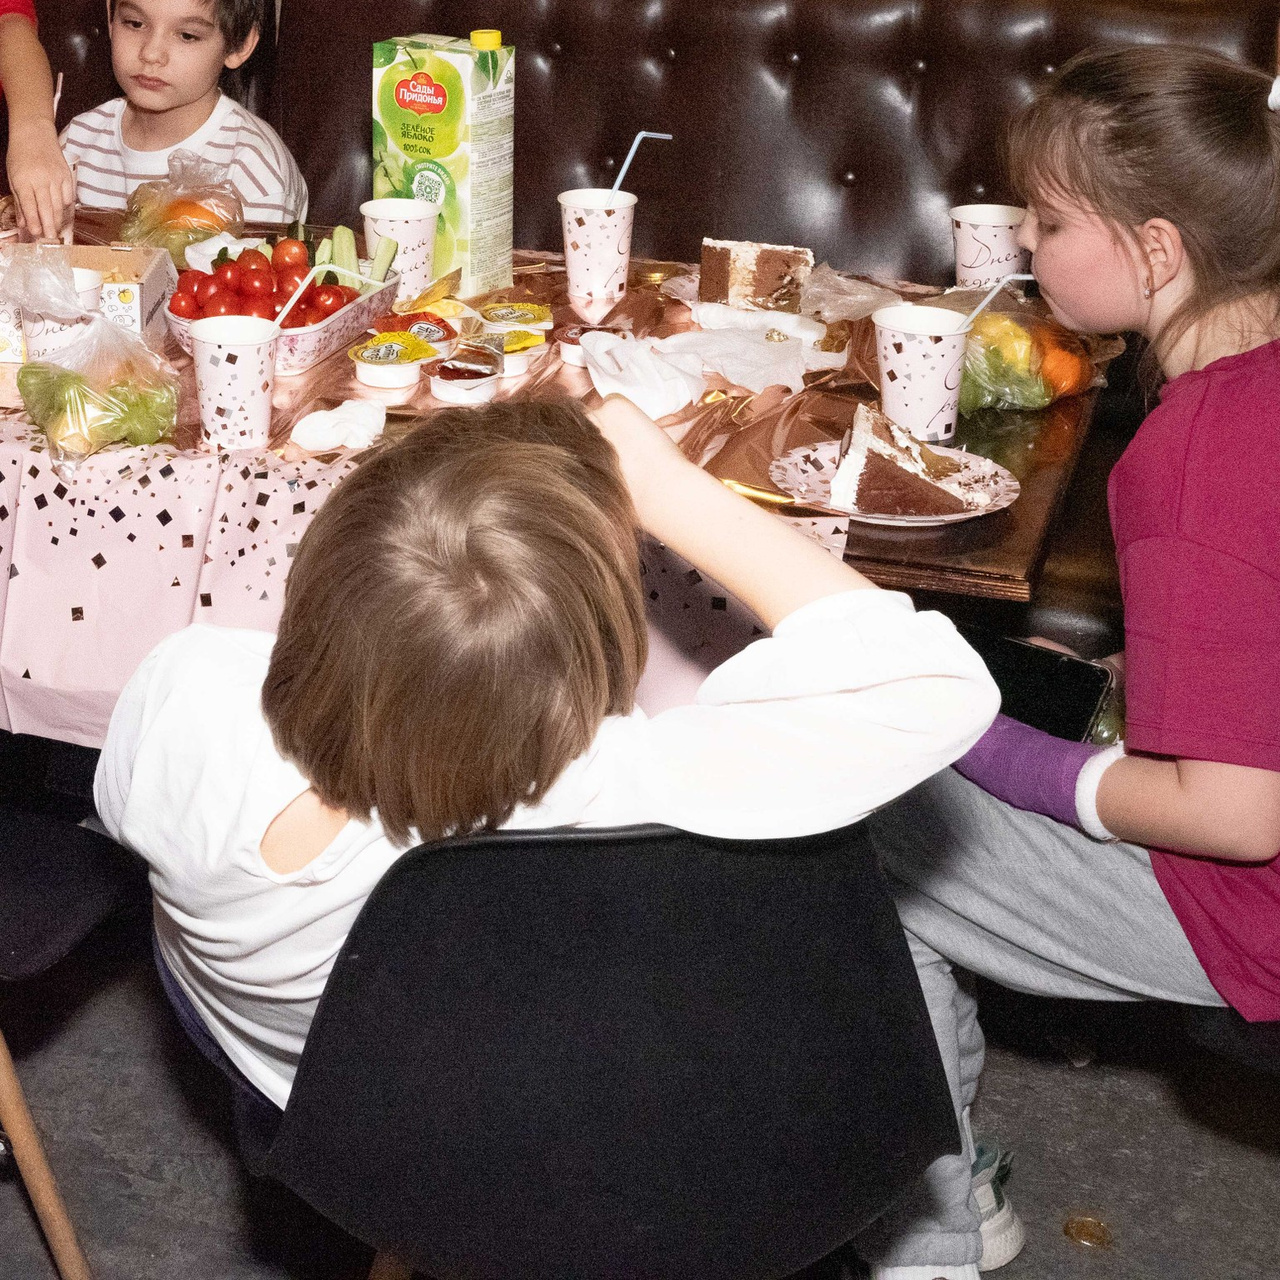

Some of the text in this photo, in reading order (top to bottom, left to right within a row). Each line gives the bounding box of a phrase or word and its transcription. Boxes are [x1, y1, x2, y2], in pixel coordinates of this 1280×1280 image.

[409, 81, 435, 95] Сады
[399, 88, 443, 105] Придонья
[401, 123, 436, 135] ЗЕЛЁНОЕ
[401, 131, 435, 143] ЯБЛОКО
[403, 143, 418, 153] 100%
